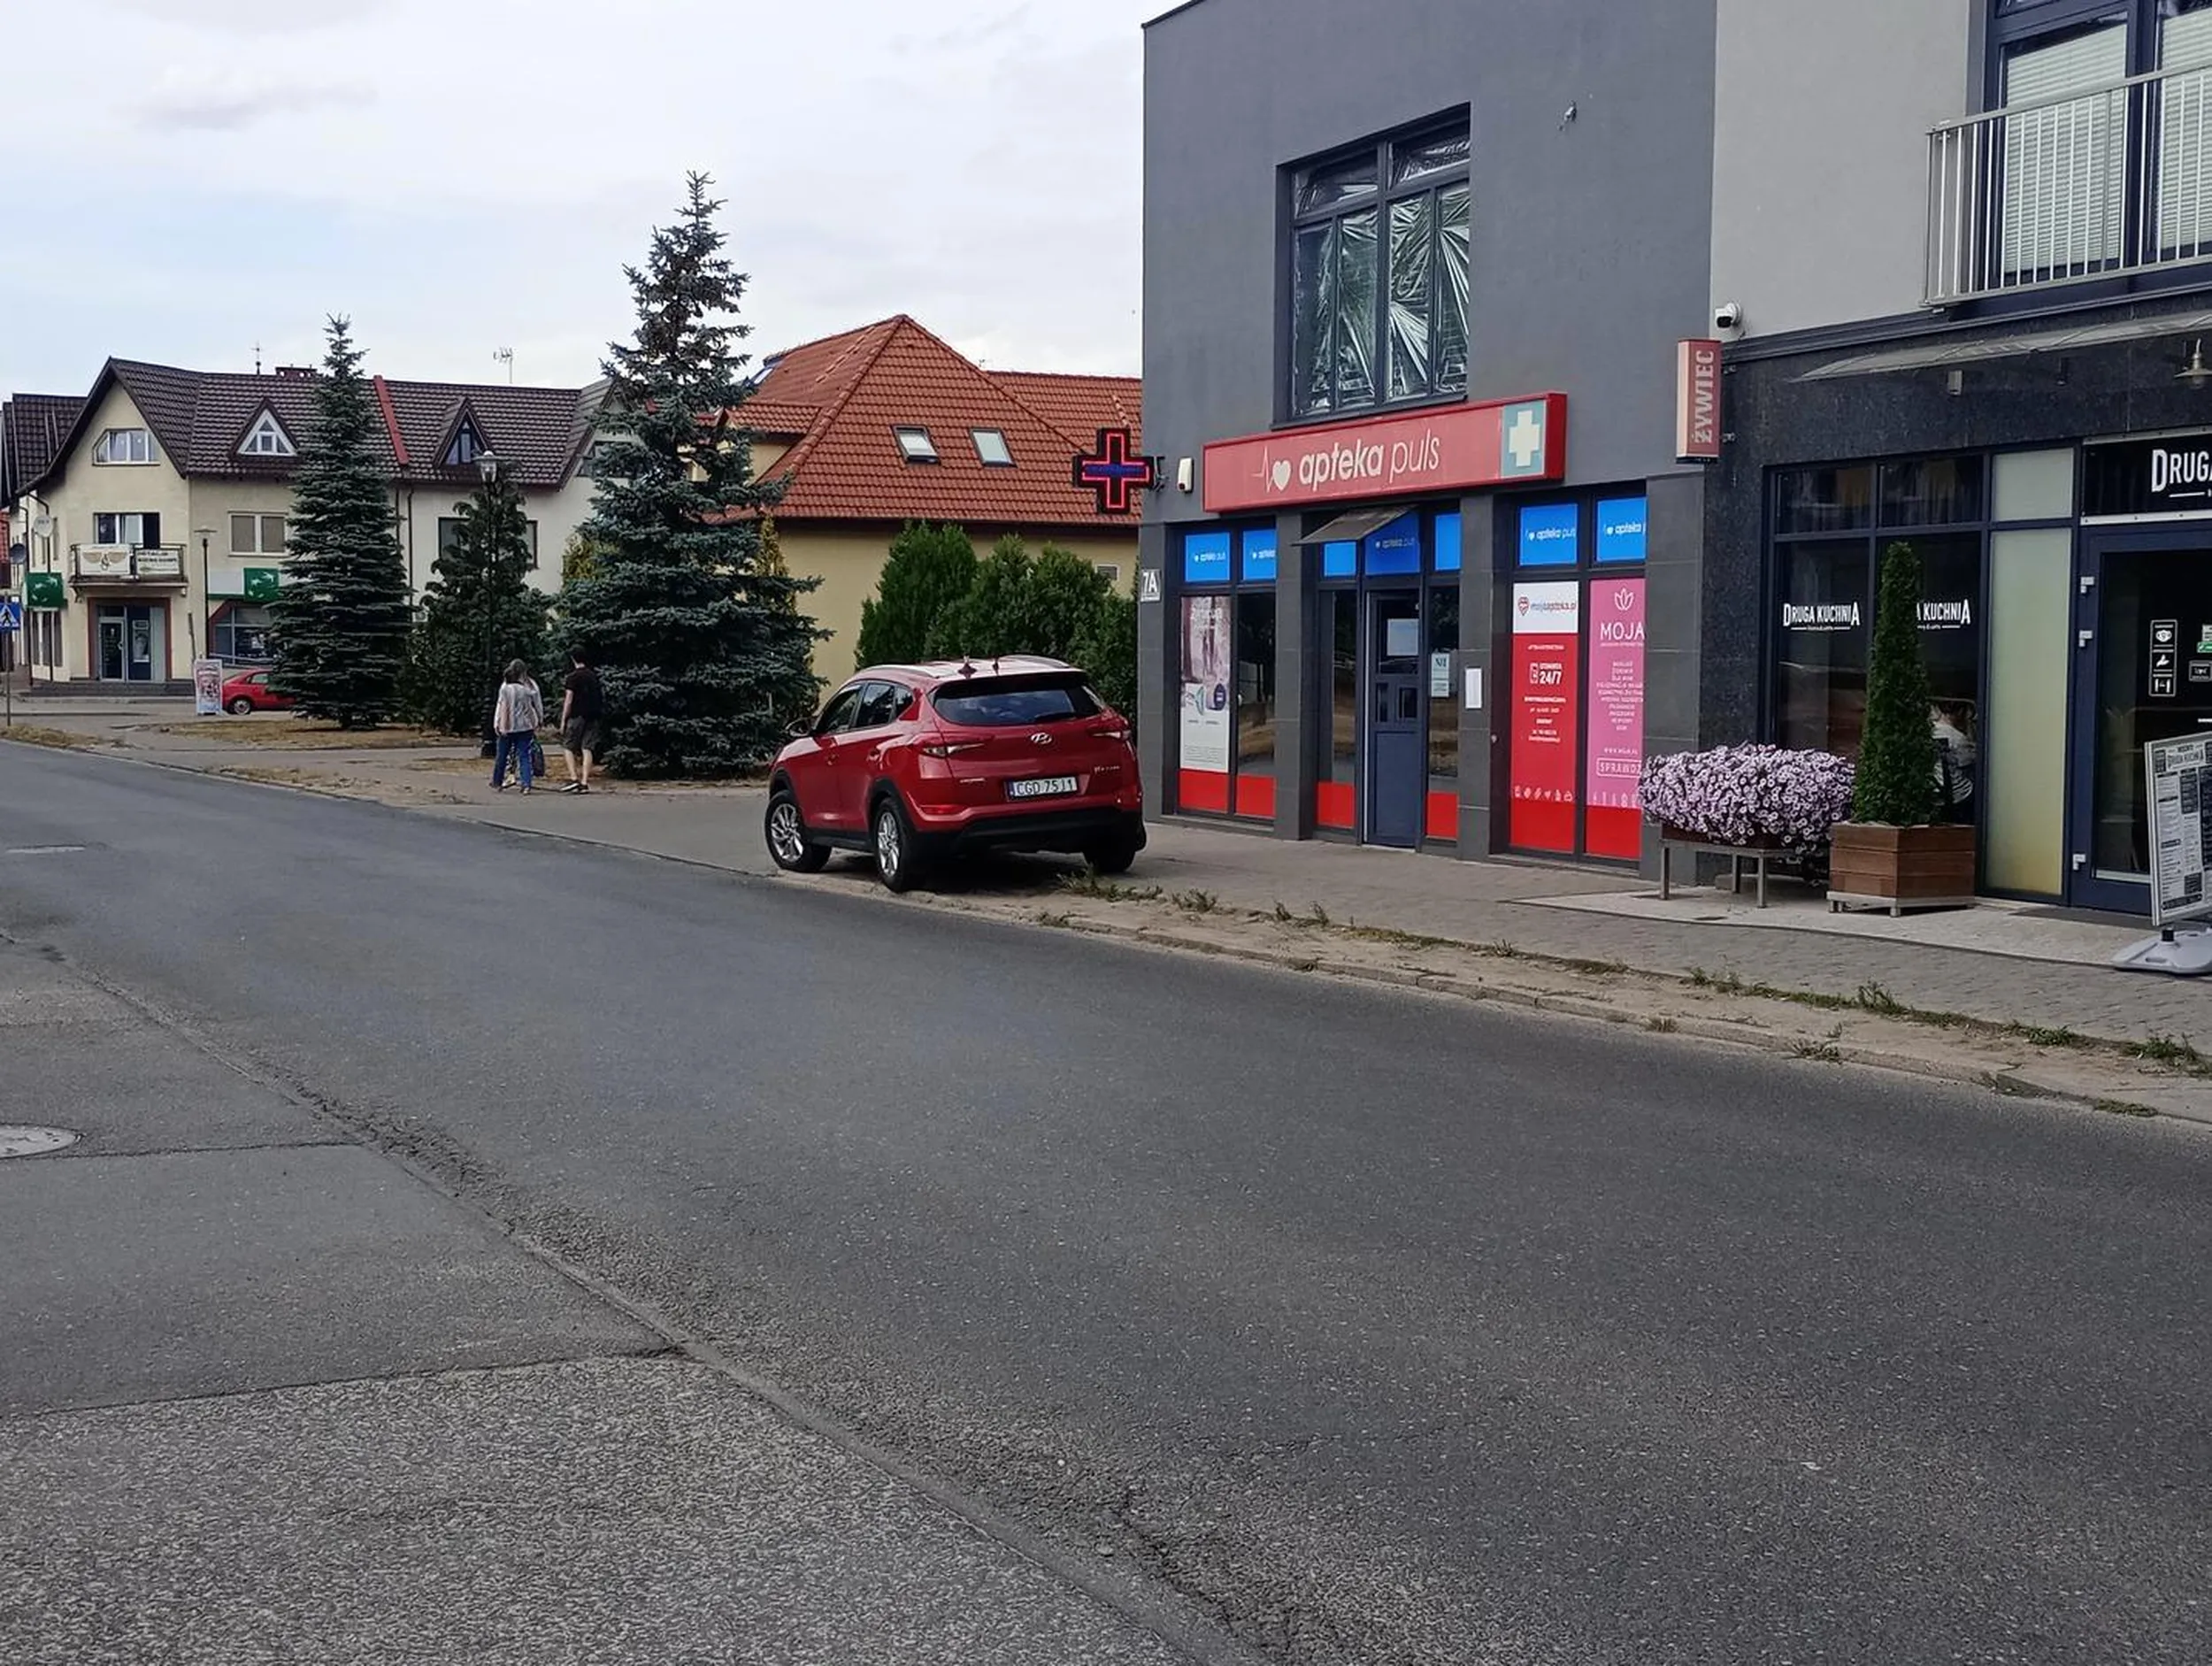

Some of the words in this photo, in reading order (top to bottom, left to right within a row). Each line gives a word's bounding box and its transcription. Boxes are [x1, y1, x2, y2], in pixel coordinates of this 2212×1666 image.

[1691, 350, 1714, 443] ŻYWIEC
[1299, 439, 1384, 492] apteka
[1388, 429, 1440, 484] puls
[2151, 449, 2212, 492] DRUG
[1142, 572, 1157, 594] 7A
[1783, 603, 1816, 626] DRUGA
[1816, 602, 1860, 626] KUCHNIA
[1923, 598, 1971, 625] KUCHNIA
[1600, 621, 1645, 641] MOJA
[1540, 671, 1562, 685] 24/7
[1017, 782, 1041, 795] CGD
[1044, 779, 1074, 793] 7511
